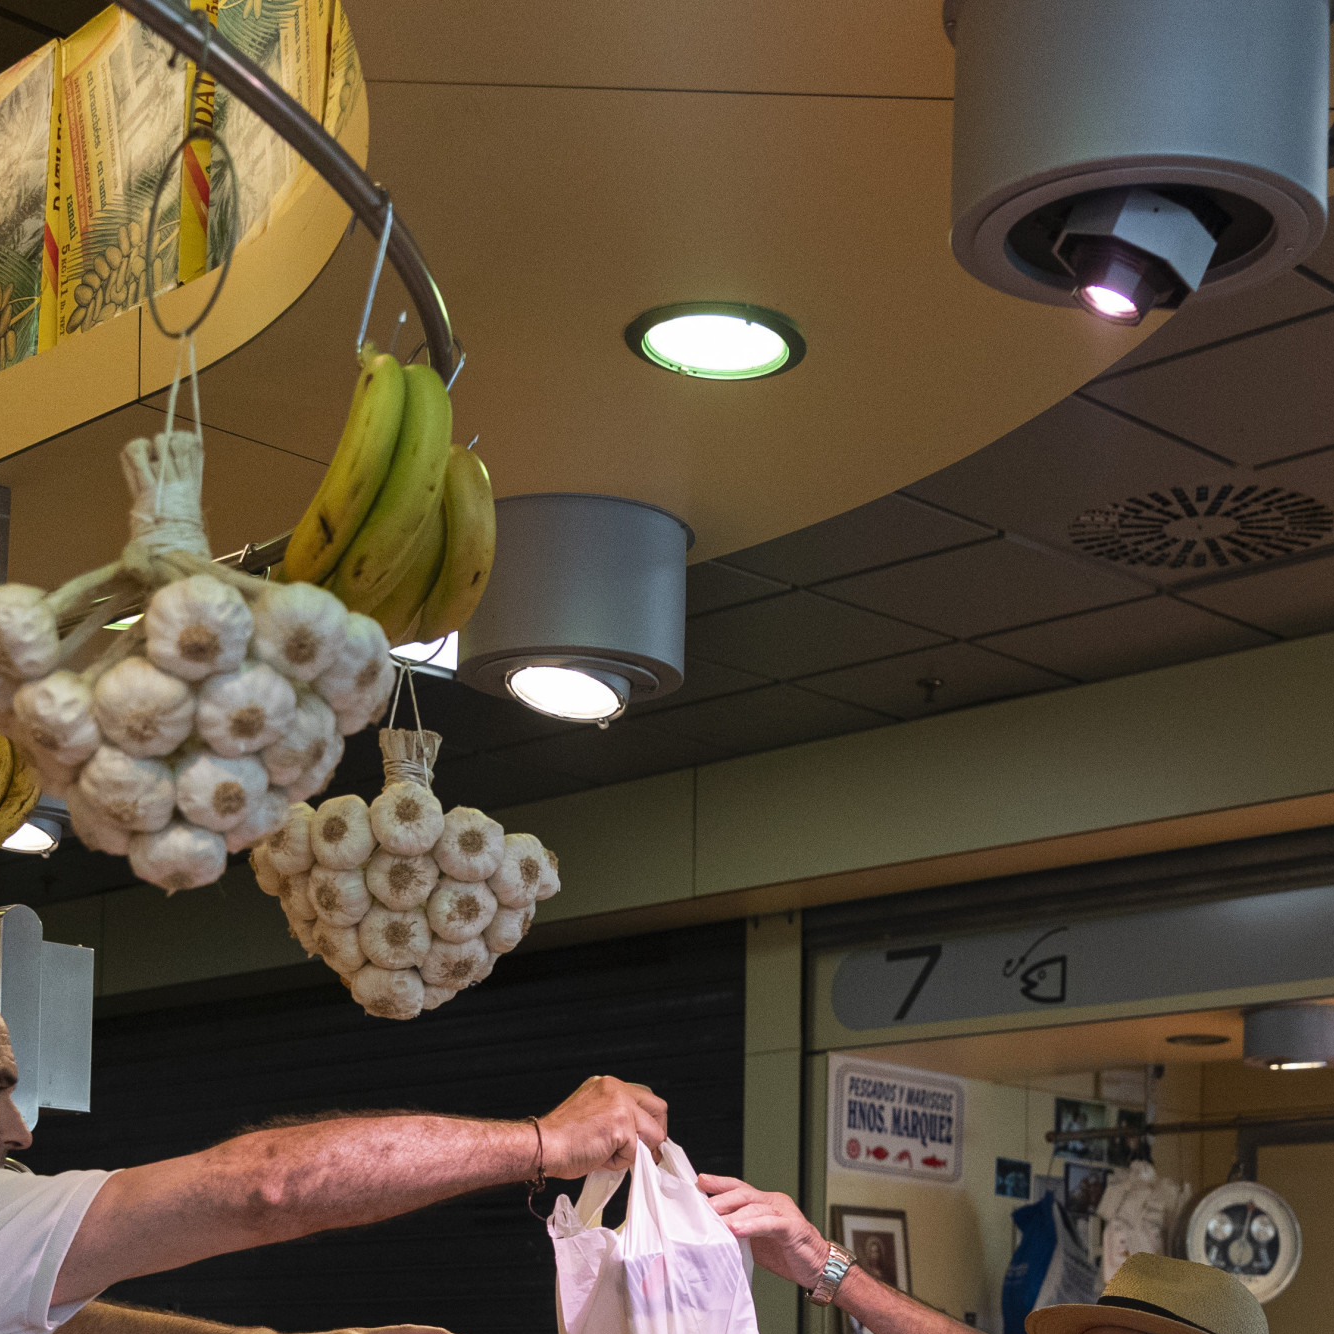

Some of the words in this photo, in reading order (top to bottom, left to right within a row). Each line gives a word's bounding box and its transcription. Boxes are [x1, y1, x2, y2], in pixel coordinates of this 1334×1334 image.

[885, 943, 944, 1022] 7
[849, 1076, 896, 1103] PESCADOS
[907, 1088, 953, 1113] MARISCOS
[847, 1100, 887, 1134] HNOS.
[891, 1106, 953, 1148] MARQUEZ
